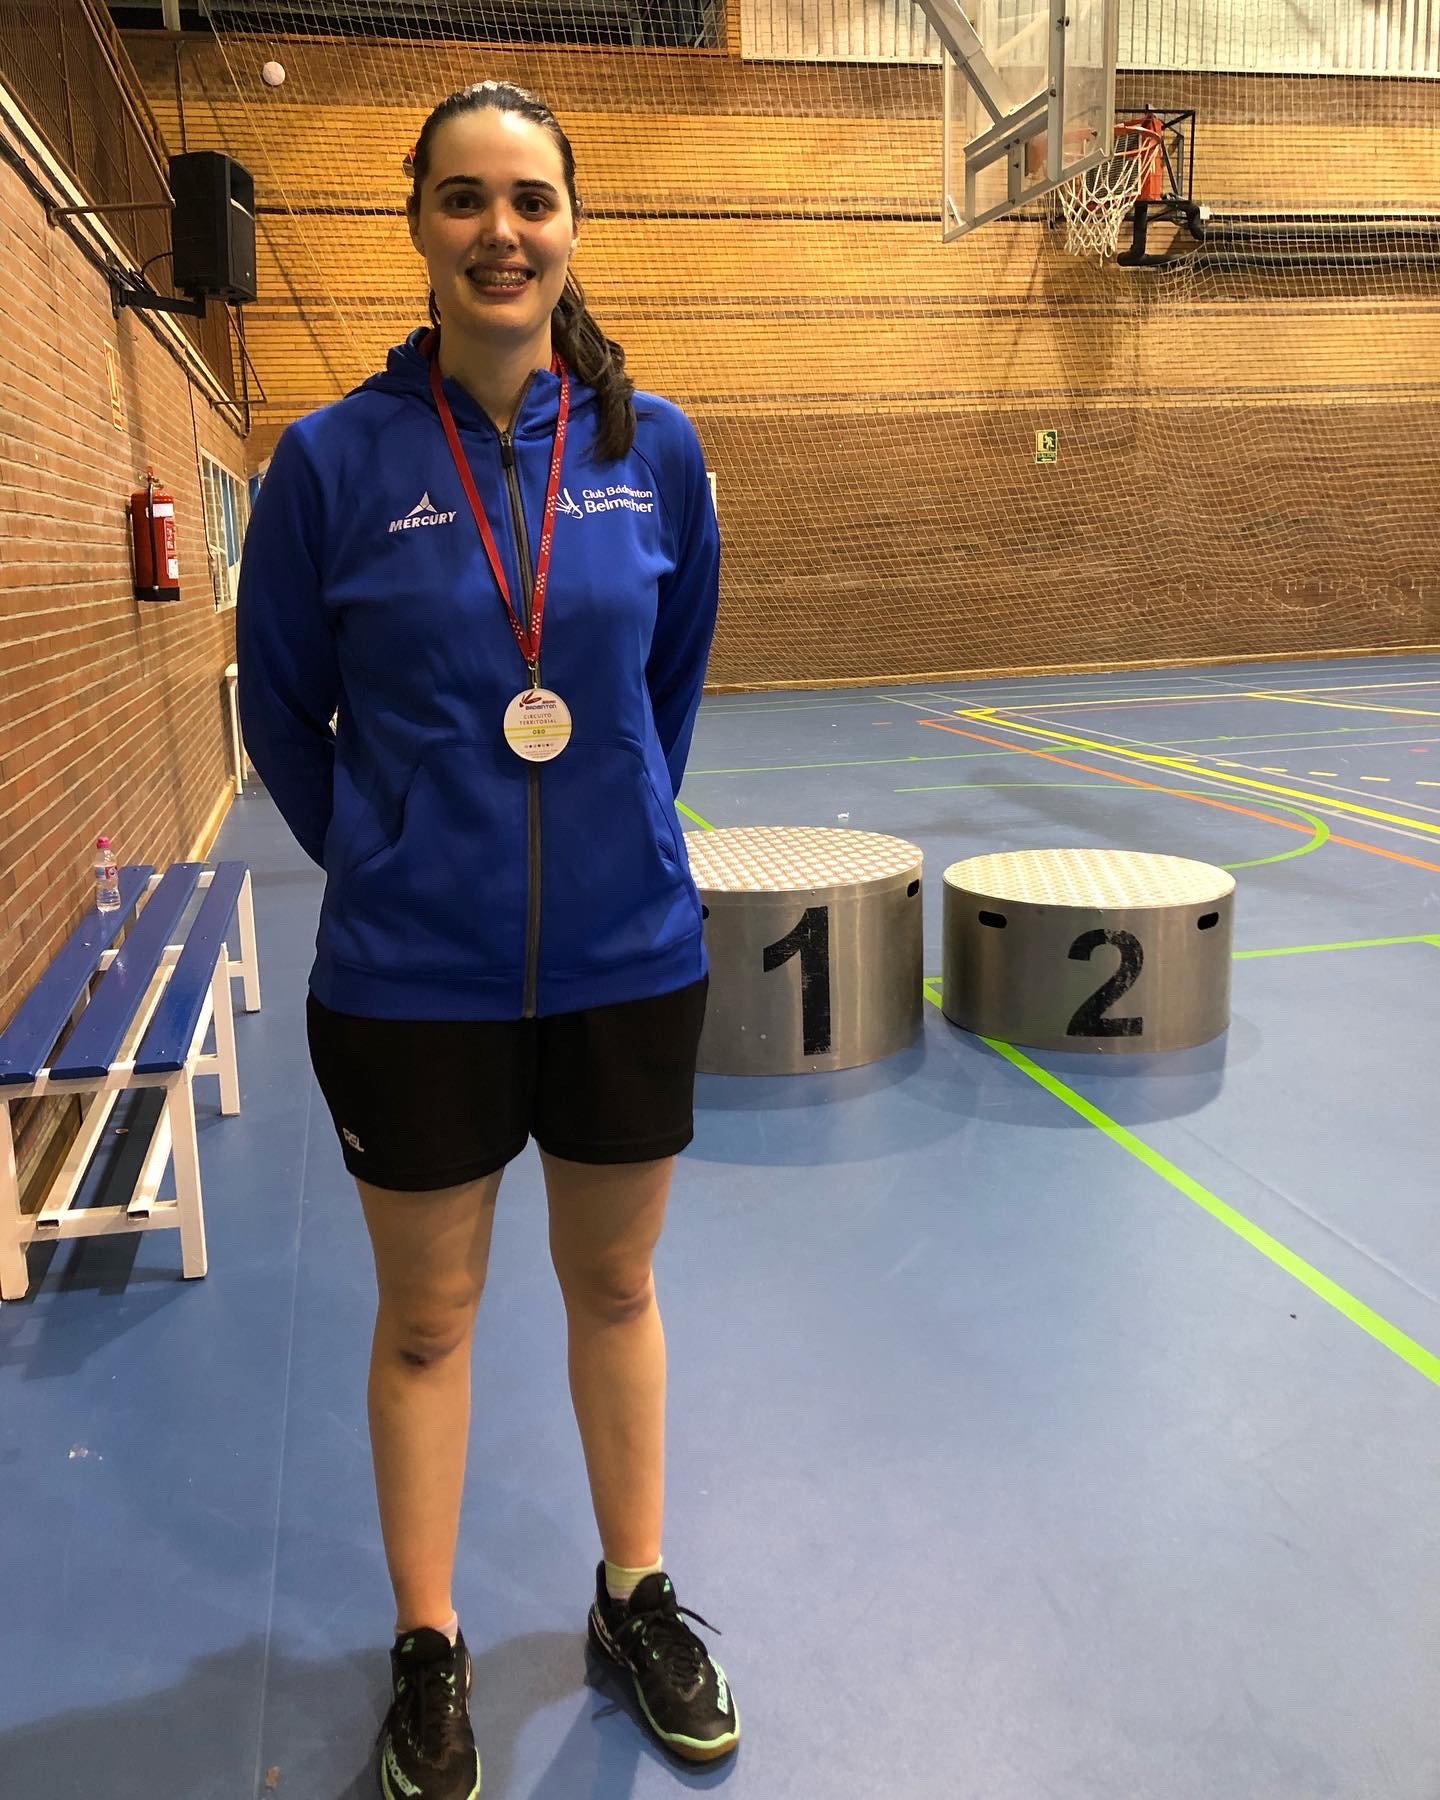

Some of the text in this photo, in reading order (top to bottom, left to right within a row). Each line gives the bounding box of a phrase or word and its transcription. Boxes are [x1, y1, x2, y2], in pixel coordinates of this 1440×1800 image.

[388, 511, 457, 533] MERCURY
[582, 489, 605, 499] Club
[763, 906, 831, 1056] 1
[1066, 928, 1144, 1037] 2
